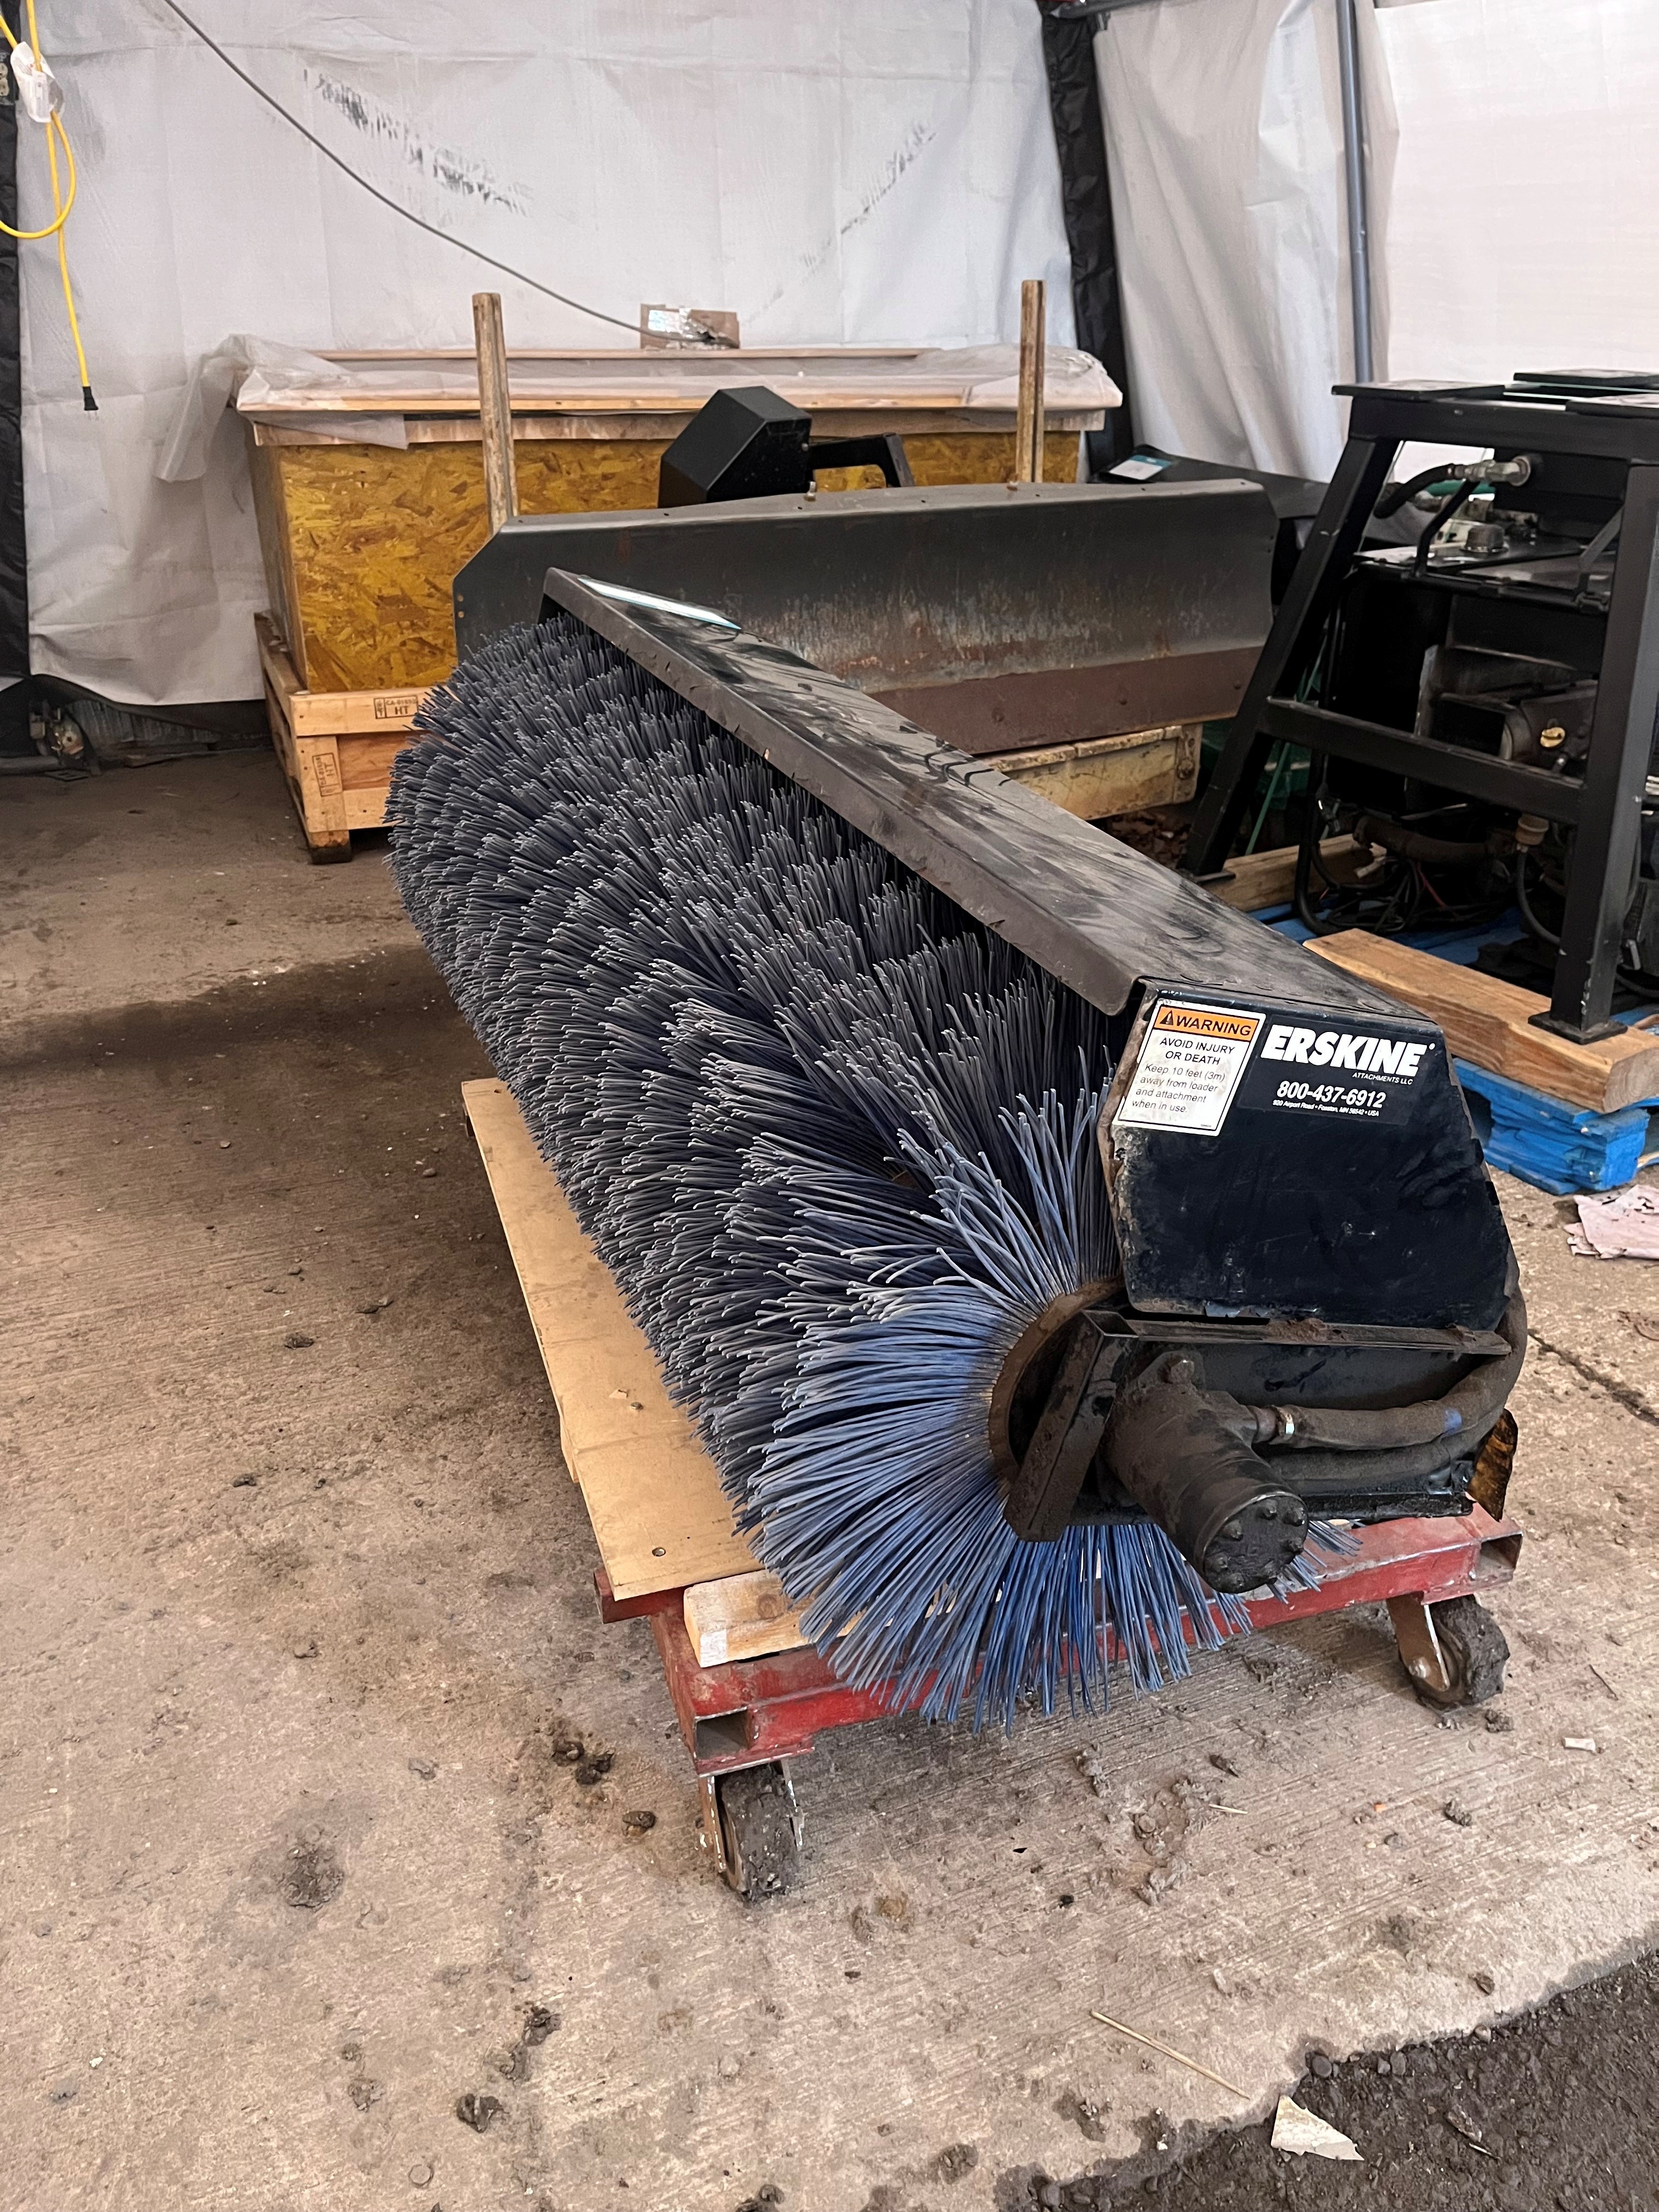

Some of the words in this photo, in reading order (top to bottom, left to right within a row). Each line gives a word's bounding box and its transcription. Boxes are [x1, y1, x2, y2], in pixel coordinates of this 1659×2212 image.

[395, 706, 408, 714] HT
[324, 763, 335, 776] HT
[1177, 1015, 1251, 1036] WARNING
[1160, 1037, 1193, 1048] AVOID
[1196, 1042, 1235, 1054] INJURY
[1260, 1024, 1427, 1077] ERSKINE
[1165, 1051, 1182, 1060] OR
[1184, 1053, 1220, 1065] DEATH
[1145, 1063, 1169, 1075] Keep
[1173, 1067, 1183, 1075] 10
[1185, 1068, 1202, 1078] feet
[1204, 1071, 1225, 1082] (3m)
[1352, 1072, 1400, 1084] ATTACHMENTS
[1400, 1077, 1413, 1085] LLC
[1140, 1077, 1164, 1087] away
[1166, 1079, 1187, 1088] from
[1189, 1081, 1218, 1091] loader
[1156, 1090, 1207, 1103] attachment
[1277, 1080, 1386, 1108] 800-437-6912
[1132, 1099, 1156, 1109] when
[1159, 1102, 1167, 1110] in
[1170, 1104, 1188, 1113] use.
